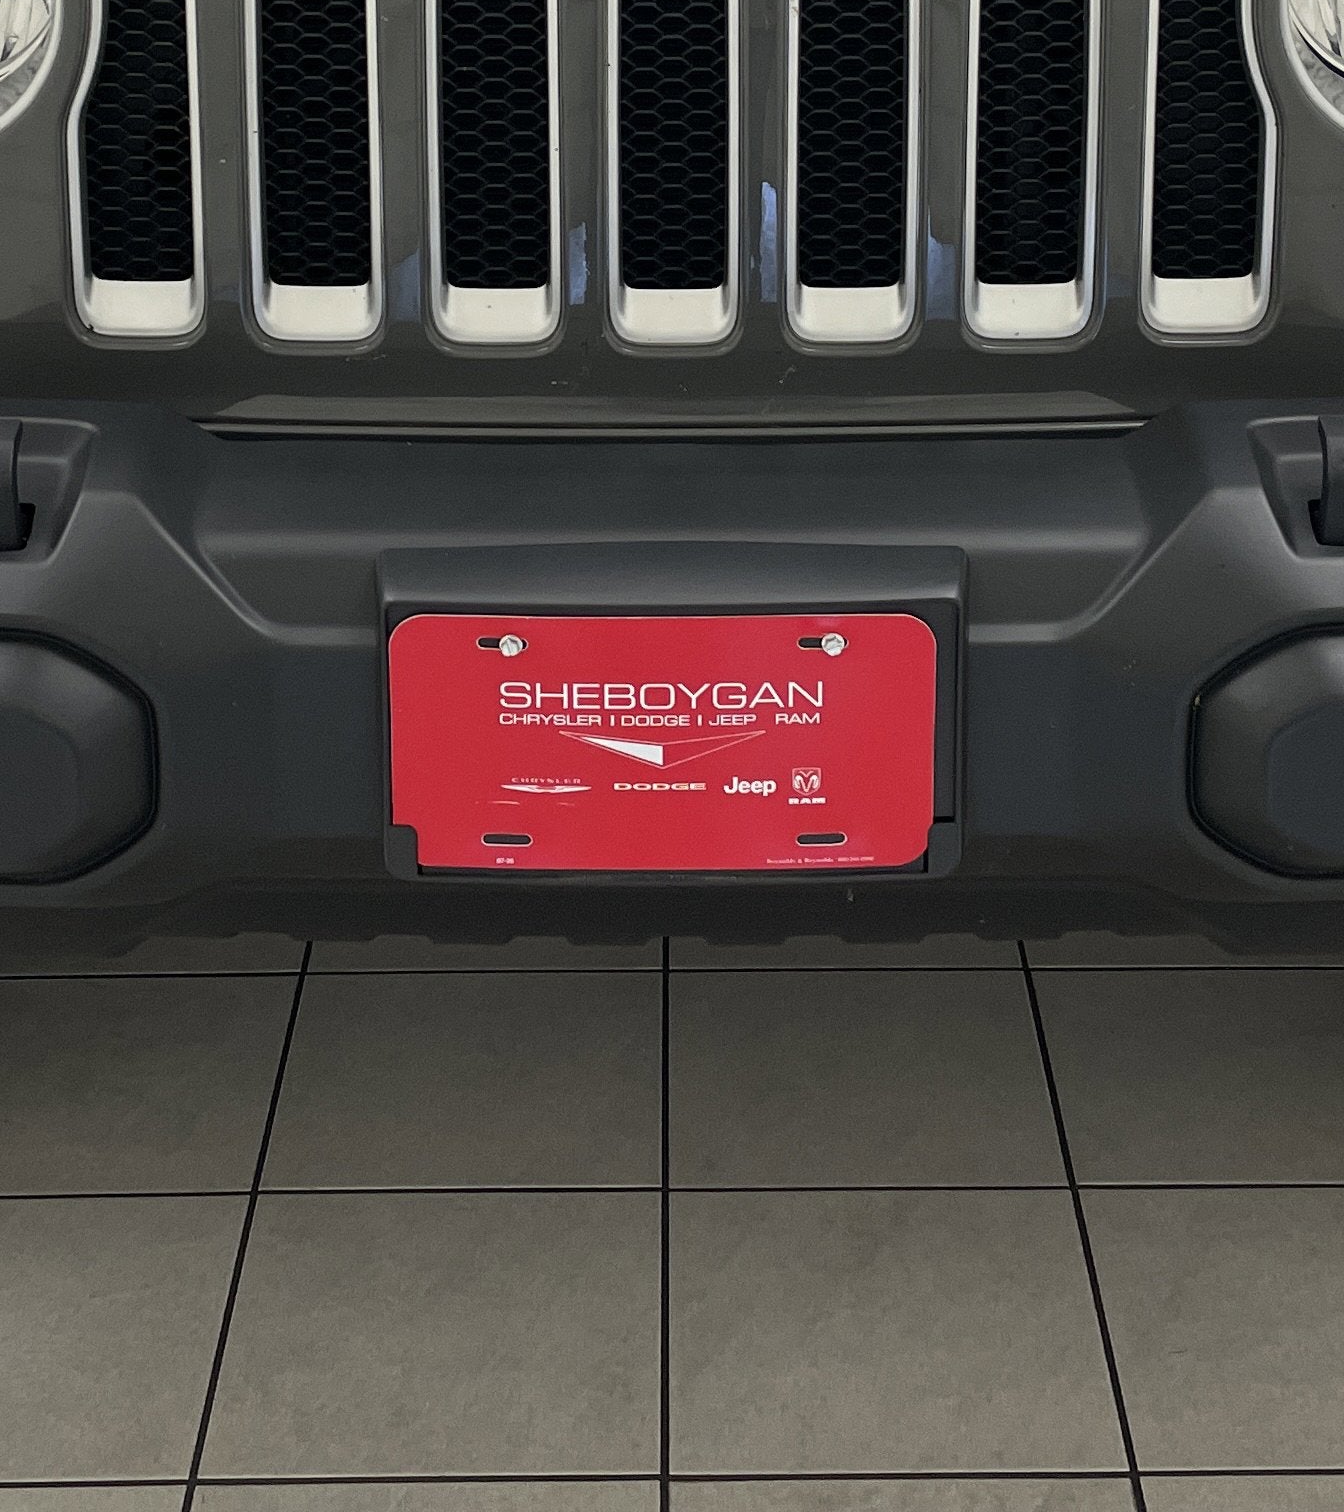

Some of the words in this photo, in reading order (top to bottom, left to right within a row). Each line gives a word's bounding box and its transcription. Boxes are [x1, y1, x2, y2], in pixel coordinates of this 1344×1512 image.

[499, 680, 824, 711] SHEBOYGAN
[499, 712, 602, 727] CHRYSLER
[620, 714, 691, 727] DODGE
[708, 714, 757, 727] JEEP
[775, 712, 821, 726] RAM
[613, 782, 707, 792] DODGE
[723, 776, 778, 797] Jeep
[787, 796, 827, 805] RAM
